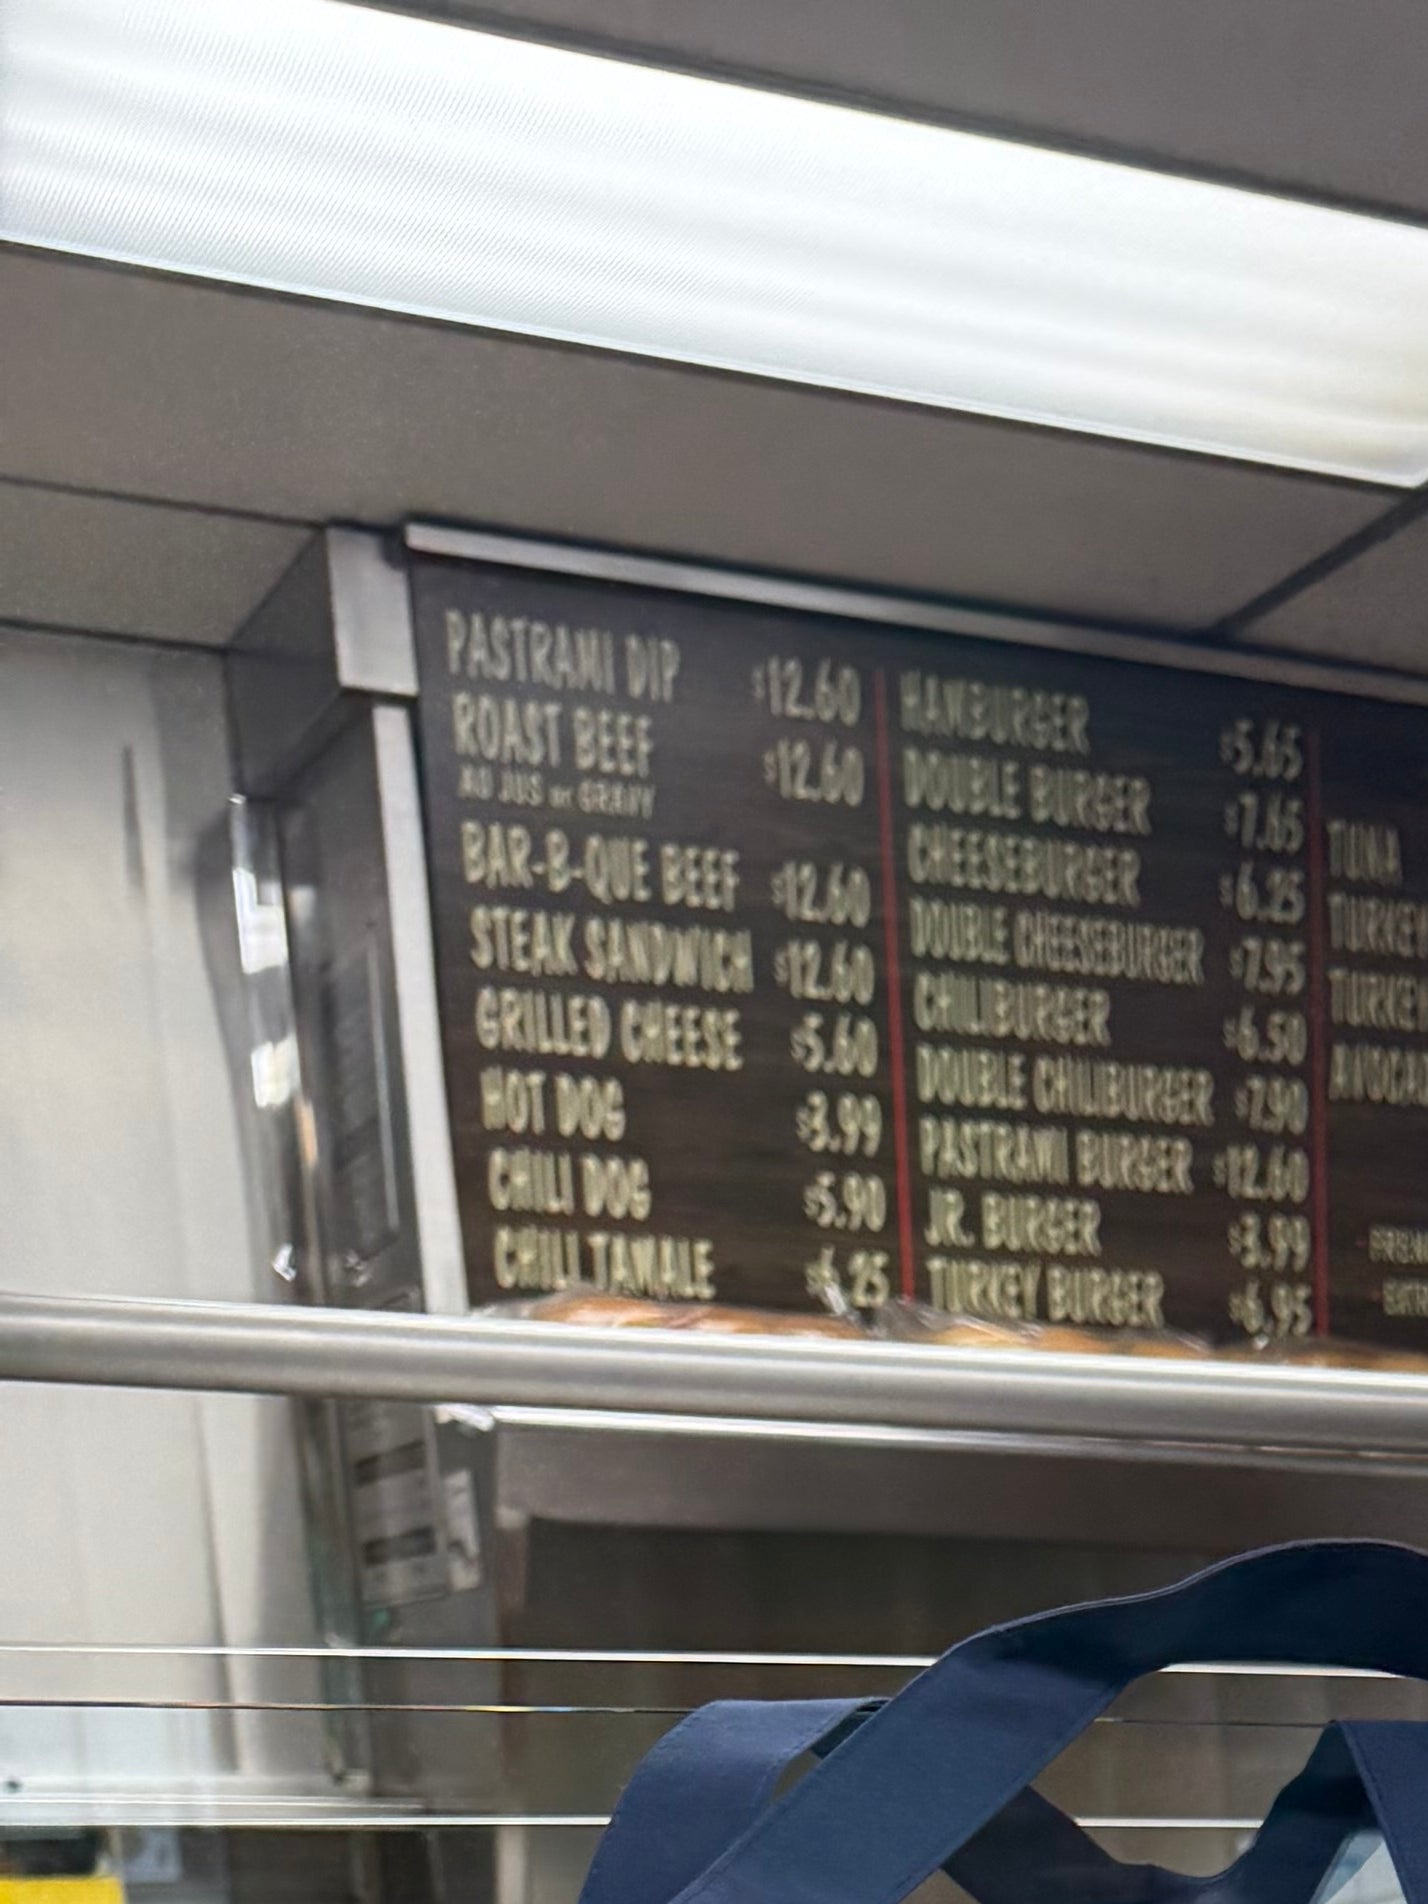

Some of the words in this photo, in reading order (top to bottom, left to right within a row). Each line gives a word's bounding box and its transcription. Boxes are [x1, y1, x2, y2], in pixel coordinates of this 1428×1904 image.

[445, 609, 615, 695] PASTRAMI
[624, 633, 681, 702] DIP
[751, 656, 861, 727] $12.60
[452, 692, 562, 767] ROAST
[573, 707, 653, 778] BEEF
[763, 738, 865, 807] $12.60
[901, 671, 1090, 755] HAMBURGER
[499, 769, 543, 807] JUS
[578, 779, 656, 819] GRAVY
[903, 748, 1021, 819] DOUBLE
[1028, 765, 1152, 836] BURGER
[461, 821, 652, 904] BAR-B-QUE
[660, 843, 741, 912] BEEF
[771, 860, 870, 928] $12.60
[906, 823, 1141, 908] CHEESEBURGER
[1326, 818, 1402, 887] TUNA
[469, 905, 577, 977] STEAK
[584, 917, 753, 993] SANDWICH
[773, 939, 875, 1005] $12.60
[909, 897, 1011, 965] DOUBLE
[1013, 909, 1204, 985] CHEESEBURGER
[1229, 935, 1306, 996] $7.95
[475, 986, 611, 1059] GRILLED
[621, 999, 743, 1071] CHEESE
[790, 1012, 879, 1077] $5.60
[913, 970, 1111, 1047] CHILIBURGER
[1222, 1005, 1307, 1066] $6.50
[480, 1067, 545, 1135] HOT
[555, 1072, 626, 1141] DOG
[795, 1090, 883, 1157] $3.99
[915, 1042, 1028, 1110] DOUBLE
[1032, 1054, 1215, 1129] CHILIBURGER
[488, 1146, 574, 1215] CHILI
[580, 1153, 652, 1221] DOG
[803, 1171, 886, 1232] $5.90
[918, 1115, 1069, 1185] PASTRAMI
[1075, 1128, 1195, 1194] BURGER
[1212, 1143, 1310, 1203] $12.60
[494, 1224, 580, 1291] CHILI
[588, 1231, 716, 1299] TAMALE
[924, 1187, 975, 1248] JR.
[981, 1190, 1102, 1257] BURGER
[1228, 1210, 1311, 1272] $3.99
[925, 1255, 1041, 1318] TURKEY
[1046, 1262, 1166, 1329] BURGER
